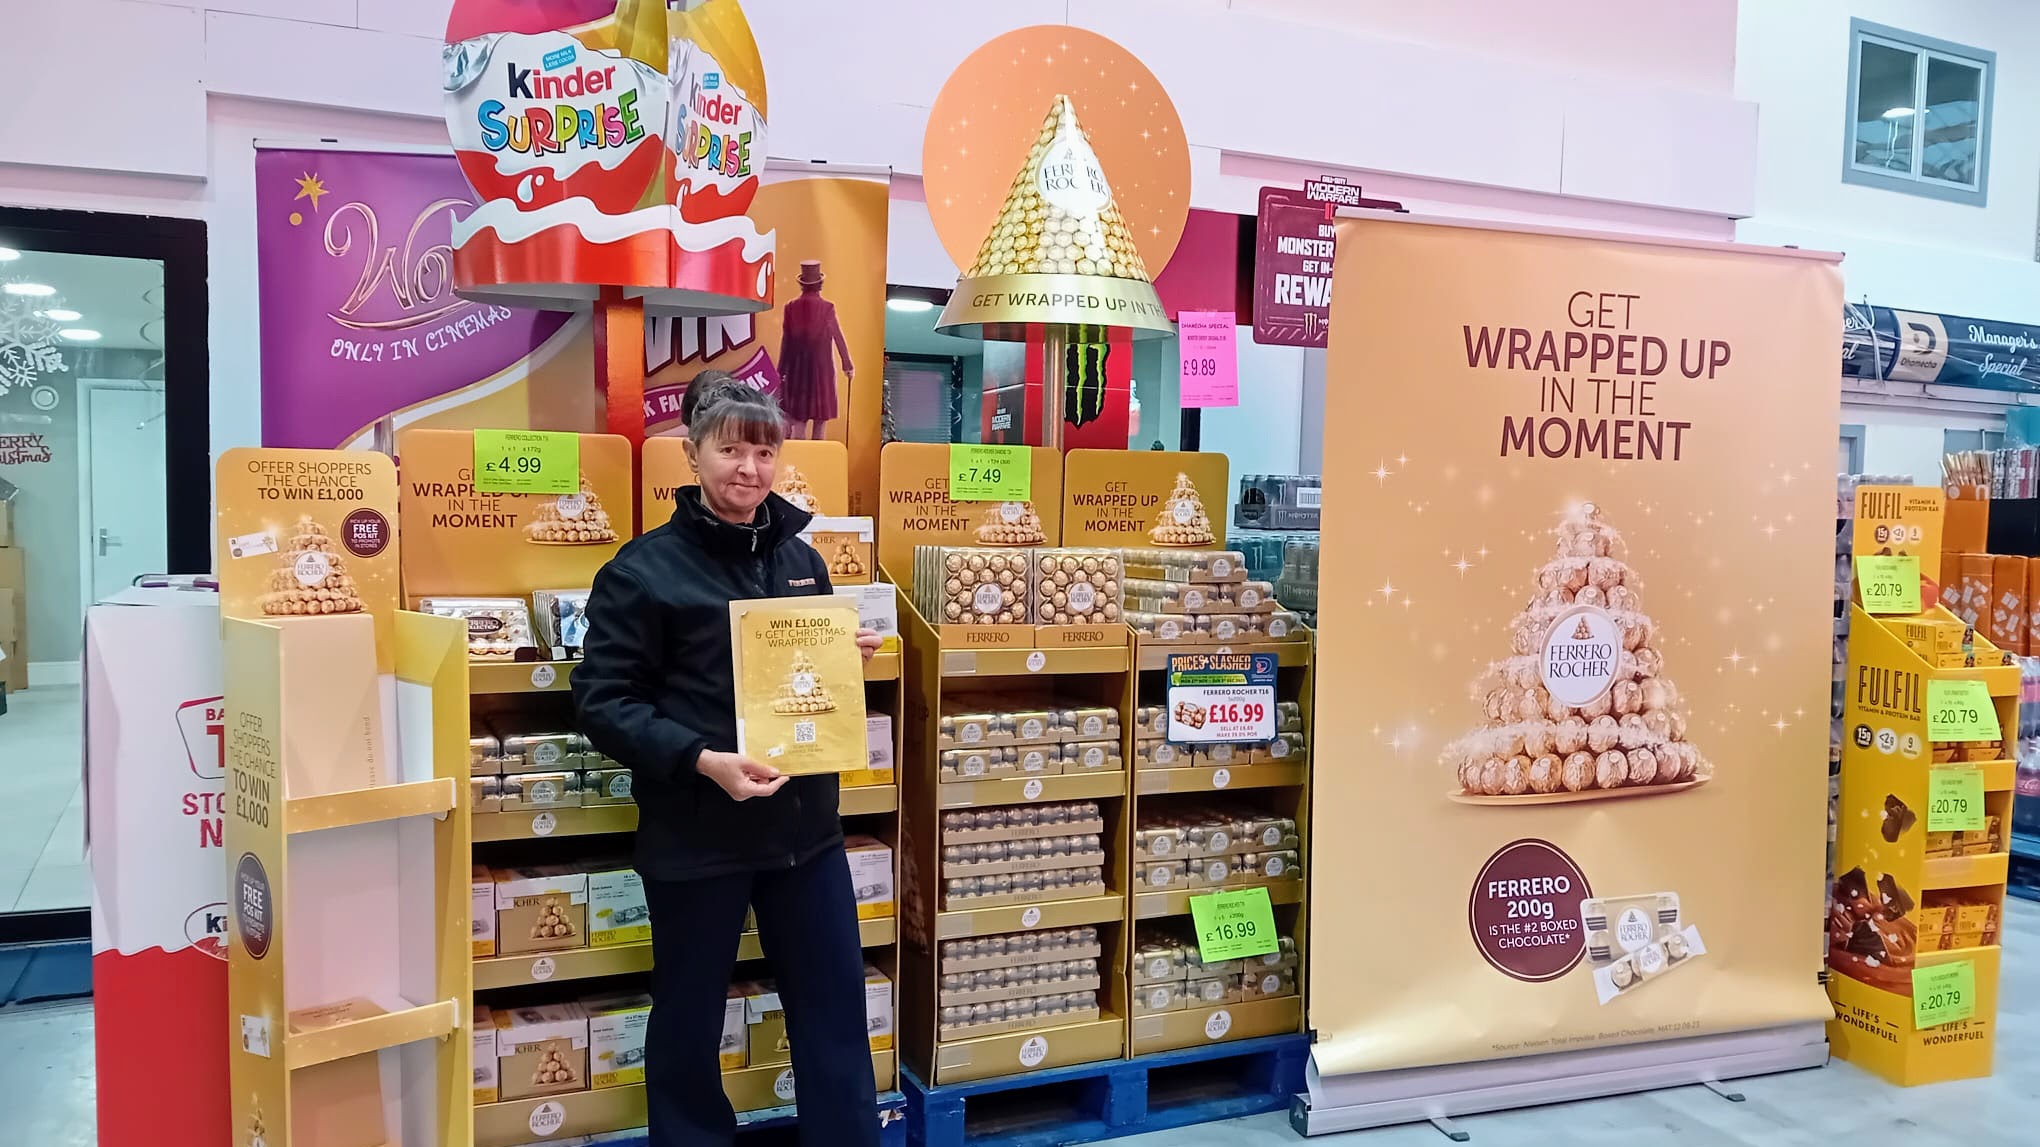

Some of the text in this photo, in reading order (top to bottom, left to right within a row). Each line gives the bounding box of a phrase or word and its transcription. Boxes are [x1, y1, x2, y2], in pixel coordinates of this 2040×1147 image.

[507, 62, 617, 99] kinder
[690, 72, 742, 125] kinder
[477, 88, 645, 157] SURPRISE
[676, 104, 752, 177] SURPRISE
[1046, 177, 1106, 195] ROCER
[1307, 181, 1360, 197] MODERN
[1306, 191, 1359, 205] WARFARE
[1318, 224, 1335, 238] BUY
[1277, 236, 1333, 258] MONSTER
[324, 199, 473, 315] Wo
[1302, 260, 1318, 273] GET
[972, 293, 1003, 308] GET
[1008, 293, 1100, 309] WRAPPED
[1105, 297, 1127, 312] UP
[1130, 301, 1147, 315] IN
[1568, 291, 1640, 330] GET
[330, 305, 512, 363] ONLY IN CINEMAS
[1968, 324, 2038, 353] Manager's
[1463, 325, 1732, 380] WRAPPED UP
[1183, 358, 1216, 376] £9.89
[1900, 357, 1938, 369] Dhamecha
[1978, 354, 2028, 379] Special
[1541, 376, 1657, 416] IN THE
[1500, 415, 1691, 461] MOMENT
[247, 460, 372, 475] OFFER SHOPPERS
[486, 456, 541, 474] £4.99
[264, 474, 358, 488] THE CHANCE
[925, 478, 949, 490] GET
[958, 468, 1001, 483] £7.49
[258, 487, 364, 502] TO WIN £1,000
[413, 483, 504, 497] WRAPP
[1105, 481, 1127, 493] GET
[448, 499, 501, 512] IN THE
[889, 491, 959, 504] WRAPPE
[1073, 494, 1159, 507] WRAPPED UP
[1860, 492, 1902, 520] FULFIL
[916, 505, 957, 517] IN THE
[1097, 507, 1134, 519] IN THE
[353, 523, 379, 533] FREE
[432, 514, 518, 528] MOMENT
[902, 518, 970, 531] MOMENT
[1084, 520, 1145, 532] MOMENT
[1866, 583, 1903, 597] £20.79
[770, 618, 831, 629] WIN £1,000
[1906, 624, 1927, 640] FULFIL
[765, 629, 785, 639] GET
[788, 627, 846, 638] CHRISTMAS
[966, 632, 1010, 643] FERRERO
[1062, 631, 1104, 642] FERRERO
[768, 636, 835, 648] WRAPPED UP
[1550, 643, 1612, 661] FERRERO
[1172, 655, 1251, 672] PRICES SLASHED
[1549, 660, 1610, 679] ROCHER
[1203, 688, 1231, 696] FERRERO
[1858, 665, 1921, 713] FULFIL
[240, 711, 263, 733] OFFER
[1209, 703, 1264, 724] £16.99
[1857, 705, 1880, 714] VITAMIN
[1885, 709, 1909, 719] PROTEIN
[1909, 714, 1921, 722] BAR
[1932, 709, 1978, 724] £20.79
[233, 728, 271, 757] SHOPPERS
[1857, 727, 1914, 749] 15g <2g 9
[230, 745, 276, 779] THE CHANCE
[233, 767, 270, 804] TO WIN
[236, 794, 269, 829] £1,000
[1930, 799, 1968, 815] £20.79
[1488, 875, 1571, 900] FERRERO
[243, 883, 263, 910] FREE
[1507, 898, 1554, 920] 200g
[1205, 921, 1256, 942] £16.99
[1489, 919, 1578, 936] IS THE #2 BOXED
[1620, 923, 1648, 932] FERRERO
[1621, 933, 1649, 942] ROCHER
[1920, 990, 1961, 1011] £20.79
[1852, 1006, 1880, 1024] LIFE'S
[1835, 1009, 1898, 1044] WONDERFUEL
[1941, 1021, 1968, 1033] LIFE'S
[1923, 1031, 1984, 1046] WONDERFUEL
[531, 1112, 562, 1121] FERRERO
[531, 1119, 561, 1128] ROCHER
